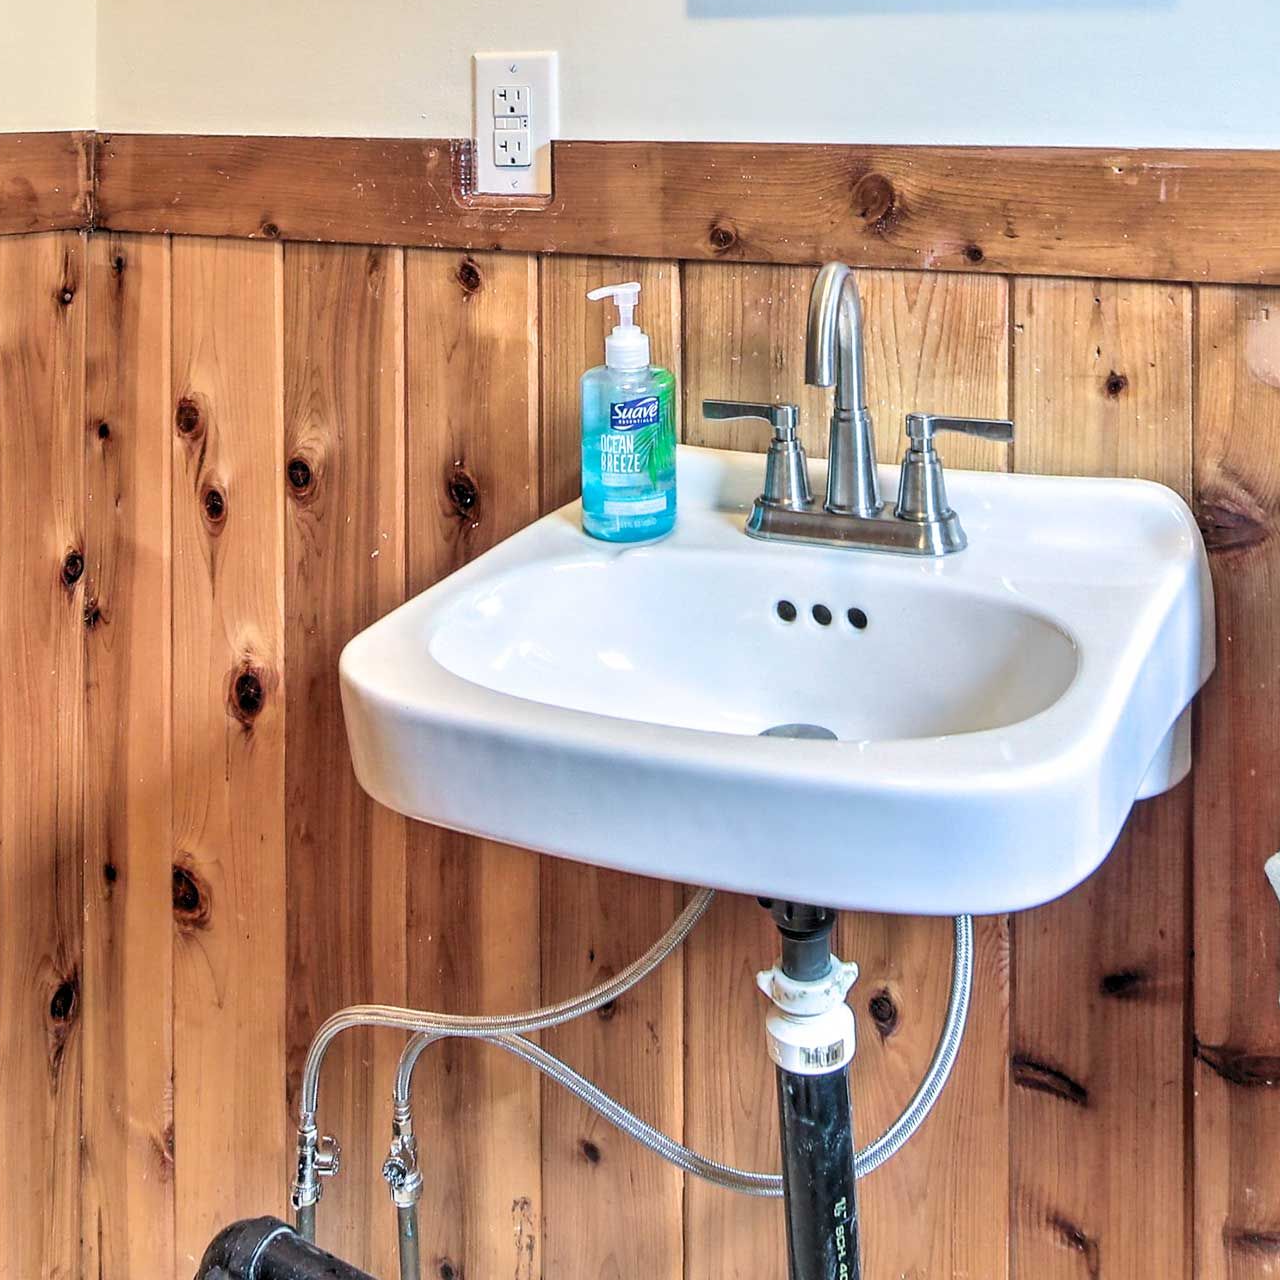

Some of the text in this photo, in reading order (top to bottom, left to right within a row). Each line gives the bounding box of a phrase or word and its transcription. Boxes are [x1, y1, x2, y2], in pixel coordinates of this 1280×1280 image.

[612, 401, 659, 420] Suave
[600, 434, 634, 454] OCEAN
[601, 452, 641, 473] BREEZE
